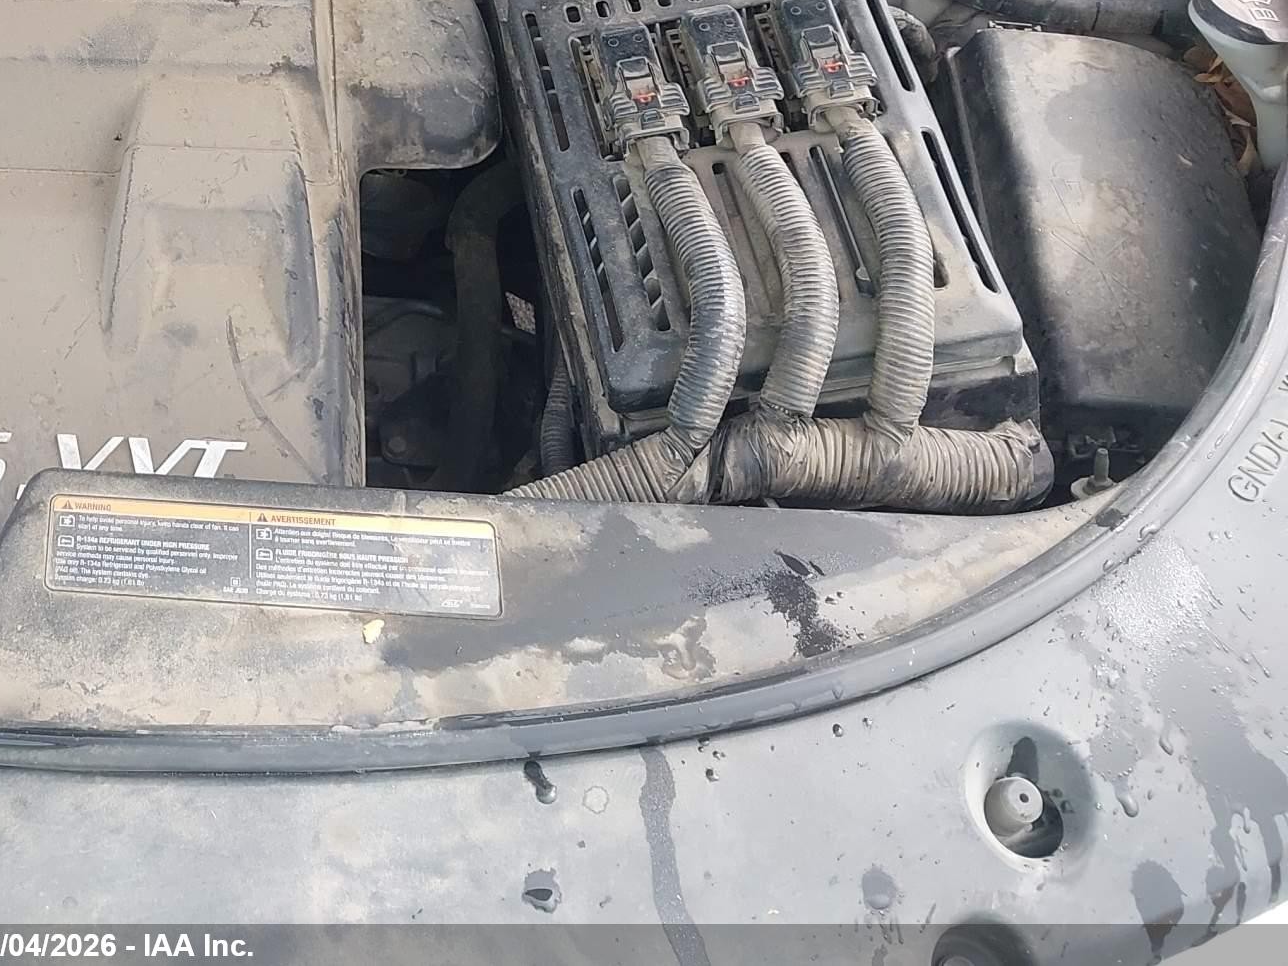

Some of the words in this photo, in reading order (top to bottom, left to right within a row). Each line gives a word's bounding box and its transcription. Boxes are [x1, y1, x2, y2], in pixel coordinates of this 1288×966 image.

[56, 433, 248, 479] VVT
[74, 502, 112, 512] WARNING
[272, 515, 336, 526] AVERTISSEMENT
